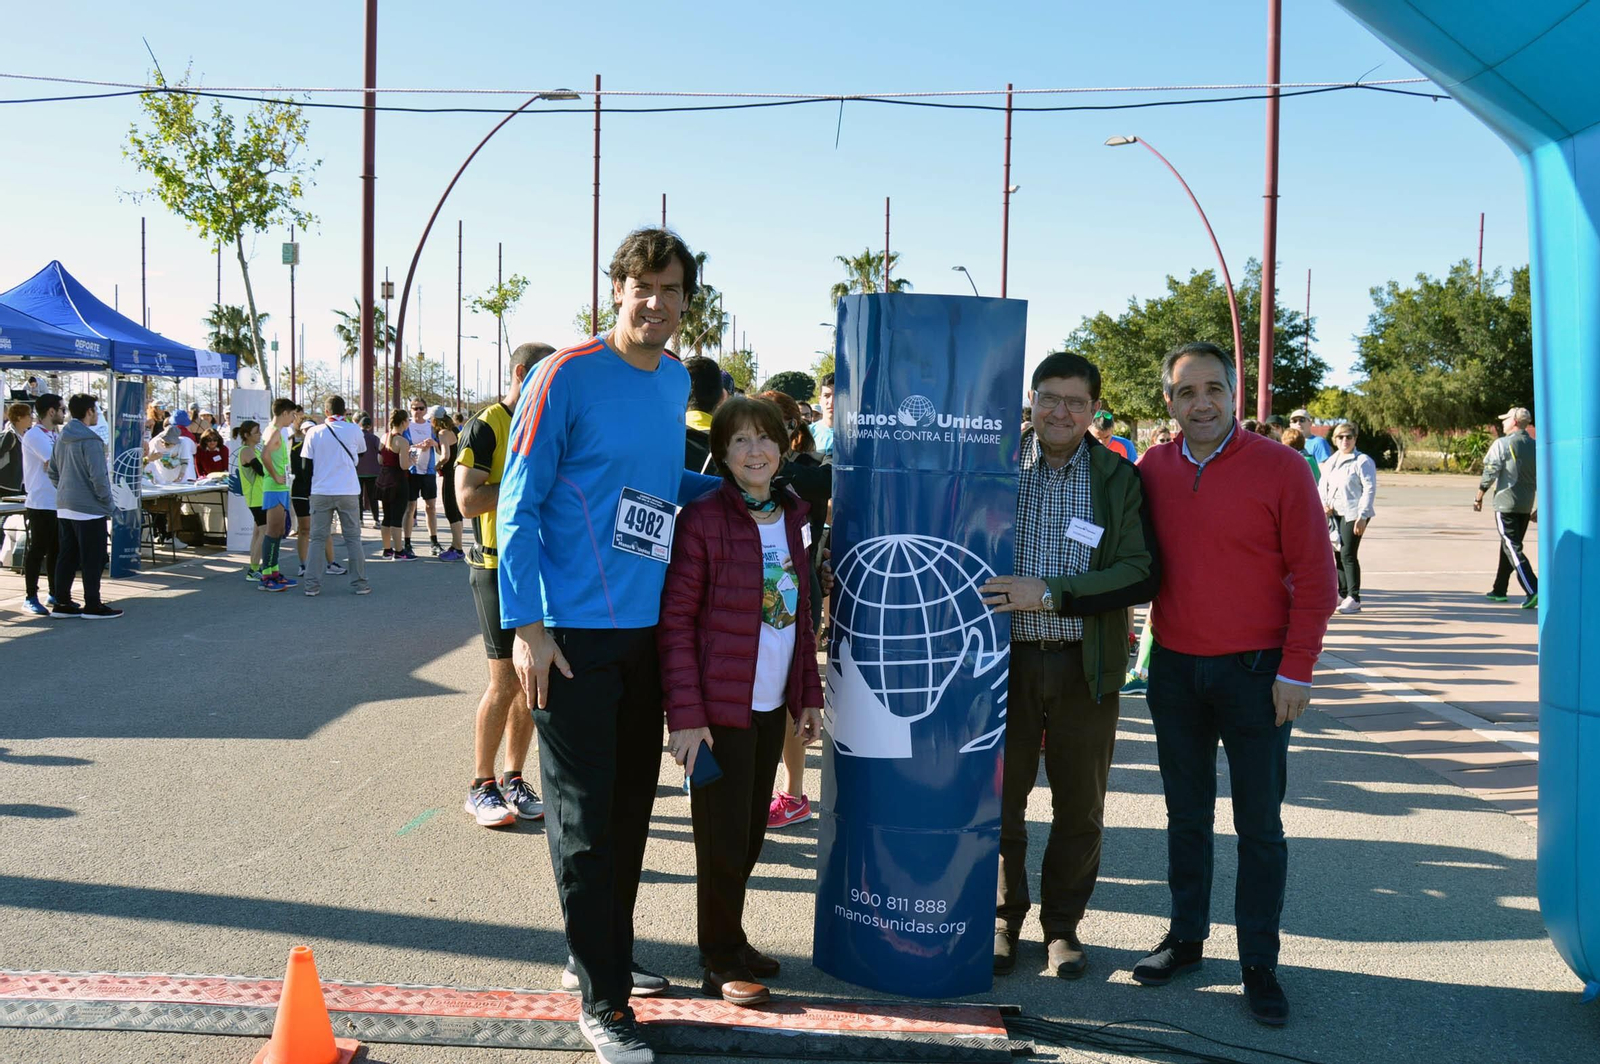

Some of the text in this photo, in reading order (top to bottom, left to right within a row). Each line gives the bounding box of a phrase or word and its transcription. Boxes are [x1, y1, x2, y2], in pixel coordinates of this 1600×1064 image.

[75, 339, 100, 352] DEPORTE
[846, 411, 1003, 431] Manos Unidas
[847, 426, 1001, 445] CAMPAÑA CONTRA EL HAMBRE
[624, 505, 665, 540] 4982
[762, 551, 780, 562] ARTE
[850, 888, 947, 914] 900 811 888
[834, 904, 966, 935] manosunidas.org
